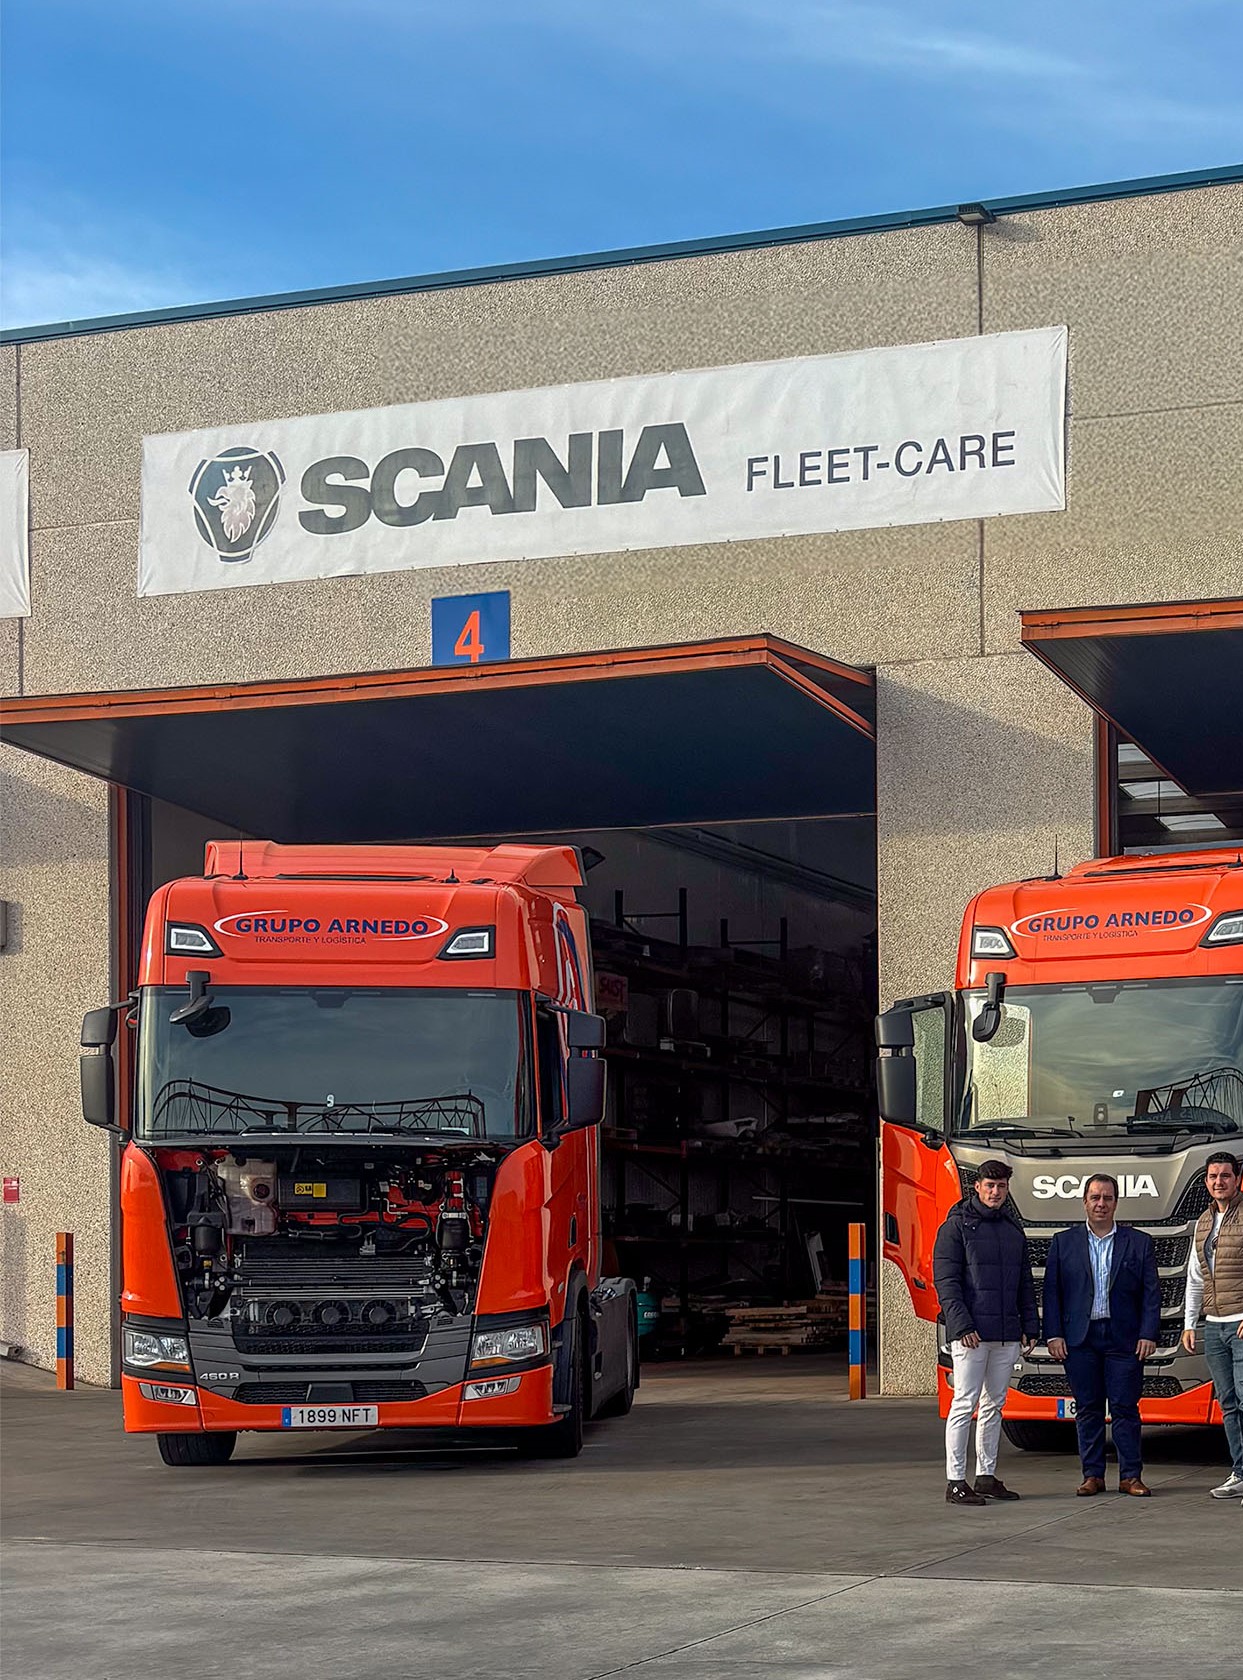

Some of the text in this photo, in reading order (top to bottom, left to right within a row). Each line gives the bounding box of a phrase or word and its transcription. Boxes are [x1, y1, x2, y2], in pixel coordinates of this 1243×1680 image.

[298, 422, 1015, 535] SCANIA FLEET-CARE
[454, 610, 485, 663] 4
[235, 918, 429, 935] GRUPO ARNEDO
[1028, 909, 1194, 933] GRUPO ARNEDO
[299, 1408, 371, 1423] 1899 NFT
